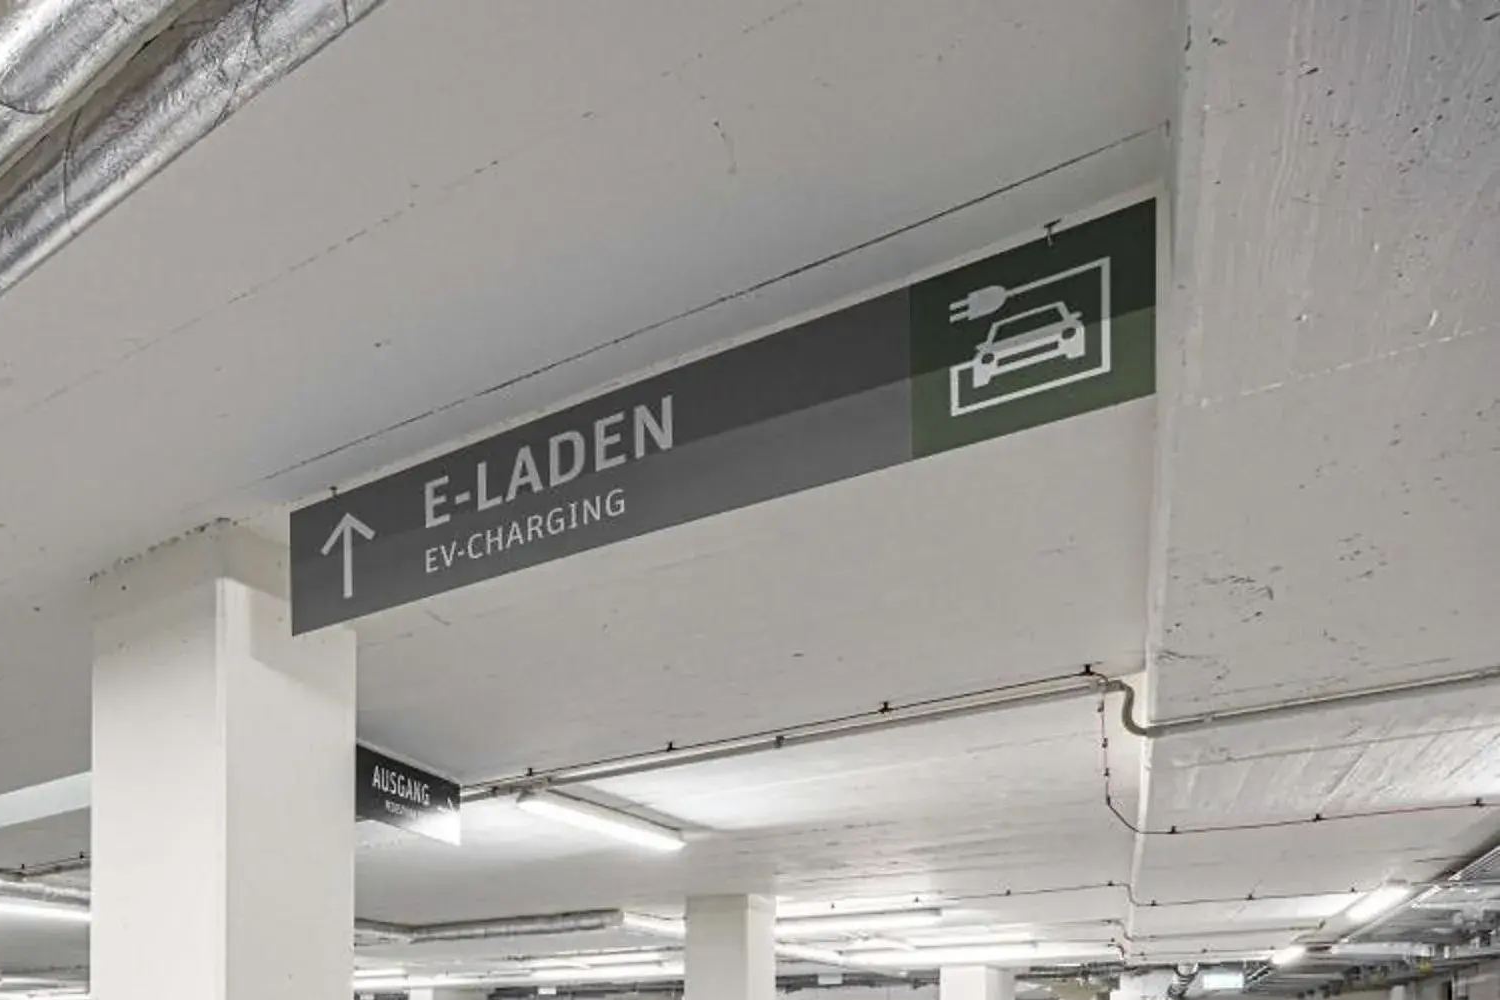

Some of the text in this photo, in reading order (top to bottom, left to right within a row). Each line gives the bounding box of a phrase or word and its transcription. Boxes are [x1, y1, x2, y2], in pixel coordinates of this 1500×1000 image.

[425, 395, 673, 528] E-LADEN
[425, 488, 625, 573] EV-CHARGING
[372, 765, 430, 808] AUSGANG
